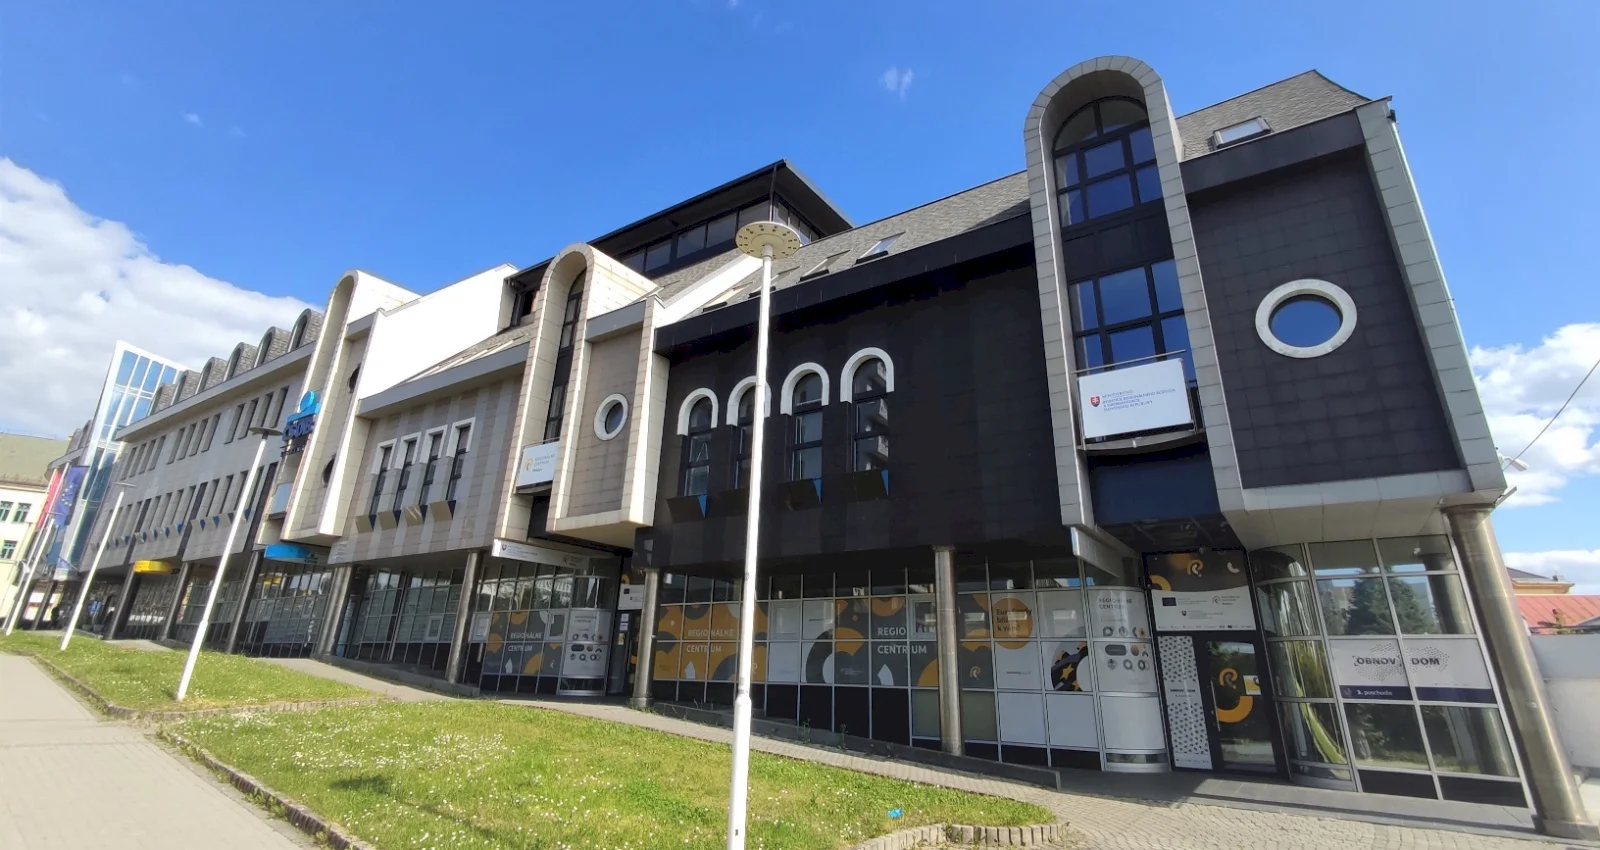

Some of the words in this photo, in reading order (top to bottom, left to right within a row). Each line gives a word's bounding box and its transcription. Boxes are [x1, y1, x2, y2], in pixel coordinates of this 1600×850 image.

[686, 645, 722, 653] CENTRUM
[877, 644, 927, 654] CENTRUM
[1411, 657, 1440, 666] DOM
